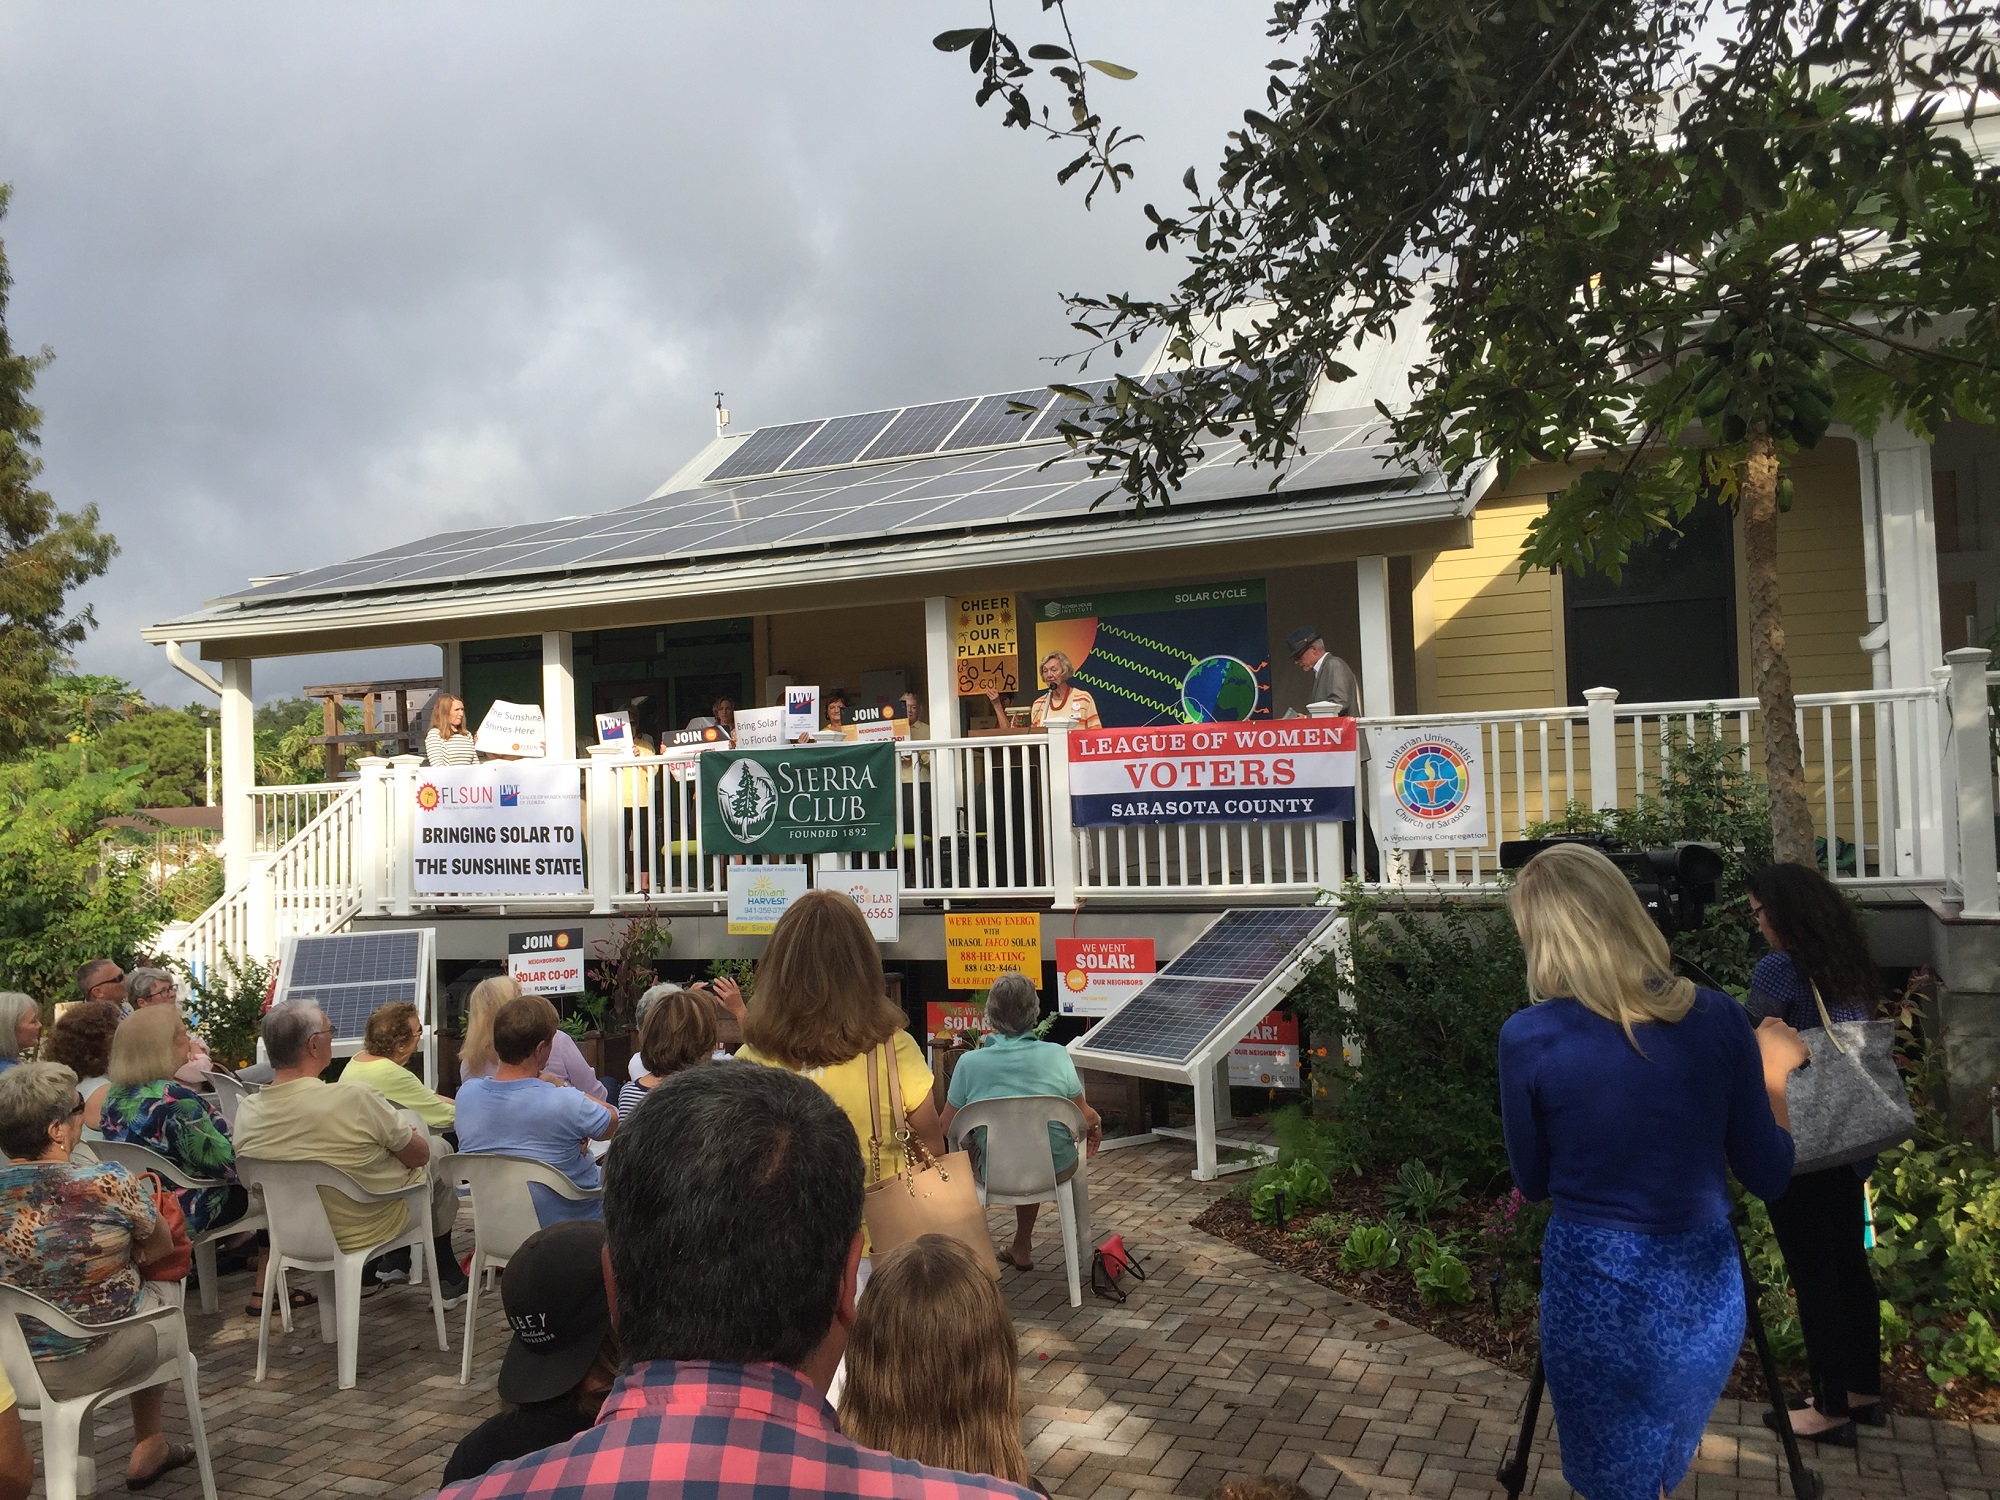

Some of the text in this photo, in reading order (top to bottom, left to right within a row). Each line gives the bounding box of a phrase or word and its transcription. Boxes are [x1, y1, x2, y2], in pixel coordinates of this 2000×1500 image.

[1175, 588, 1246, 603] SOLAR CYCLE
[961, 597, 1010, 612] CHEER
[976, 614, 994, 626] UP
[970, 628, 1000, 640] OUR
[958, 642, 1016, 657] PLANET
[979, 676, 998, 690] GO!
[490, 708, 542, 722] The Sunshine
[852, 707, 880, 721] JOIN
[484, 721, 535, 734] Shines Here
[737, 718, 778, 732] Bring Solar
[673, 730, 702, 744] JOIN
[742, 734, 777, 746] to Florida
[1079, 728, 1343, 756] LEAGUE OF WOMEN
[1386, 733, 1475, 770] Unitarian Universalist
[778, 762, 877, 794] SIERRA
[1124, 758, 1296, 789] VOTERS
[442, 786, 493, 804] FLSUN
[788, 793, 866, 823] CLUB
[1111, 798, 1314, 817] SARASOTA COUNTY
[1395, 804, 1471, 829] Church of Sarasota
[422, 826, 574, 844] BRINGING SOLAR TO
[789, 828, 867, 838] FOUNDED 1892
[1390, 834, 1432, 842] Welcoming
[415, 858, 582, 875] THE SUNSHINE STATE
[948, 916, 1036, 926] WE'RE SAVING ENERGY
[522, 934, 553, 950] JOIN
[948, 938, 1036, 946] MIRASOL FAFCO SOLAR
[1082, 944, 1126, 952] WE WENT
[528, 957, 565, 965] NEIGHBORHOOD
[960, 952, 1025, 961] 888-HEATING
[1076, 954, 1135, 969] SOLAR!
[964, 964, 1021, 972] 888 (432-8464)
[516, 969, 578, 983] SOLAR CO-OP!
[965, 1007, 984, 1015] WEN
[510, 1312, 546, 1330] OBEY
